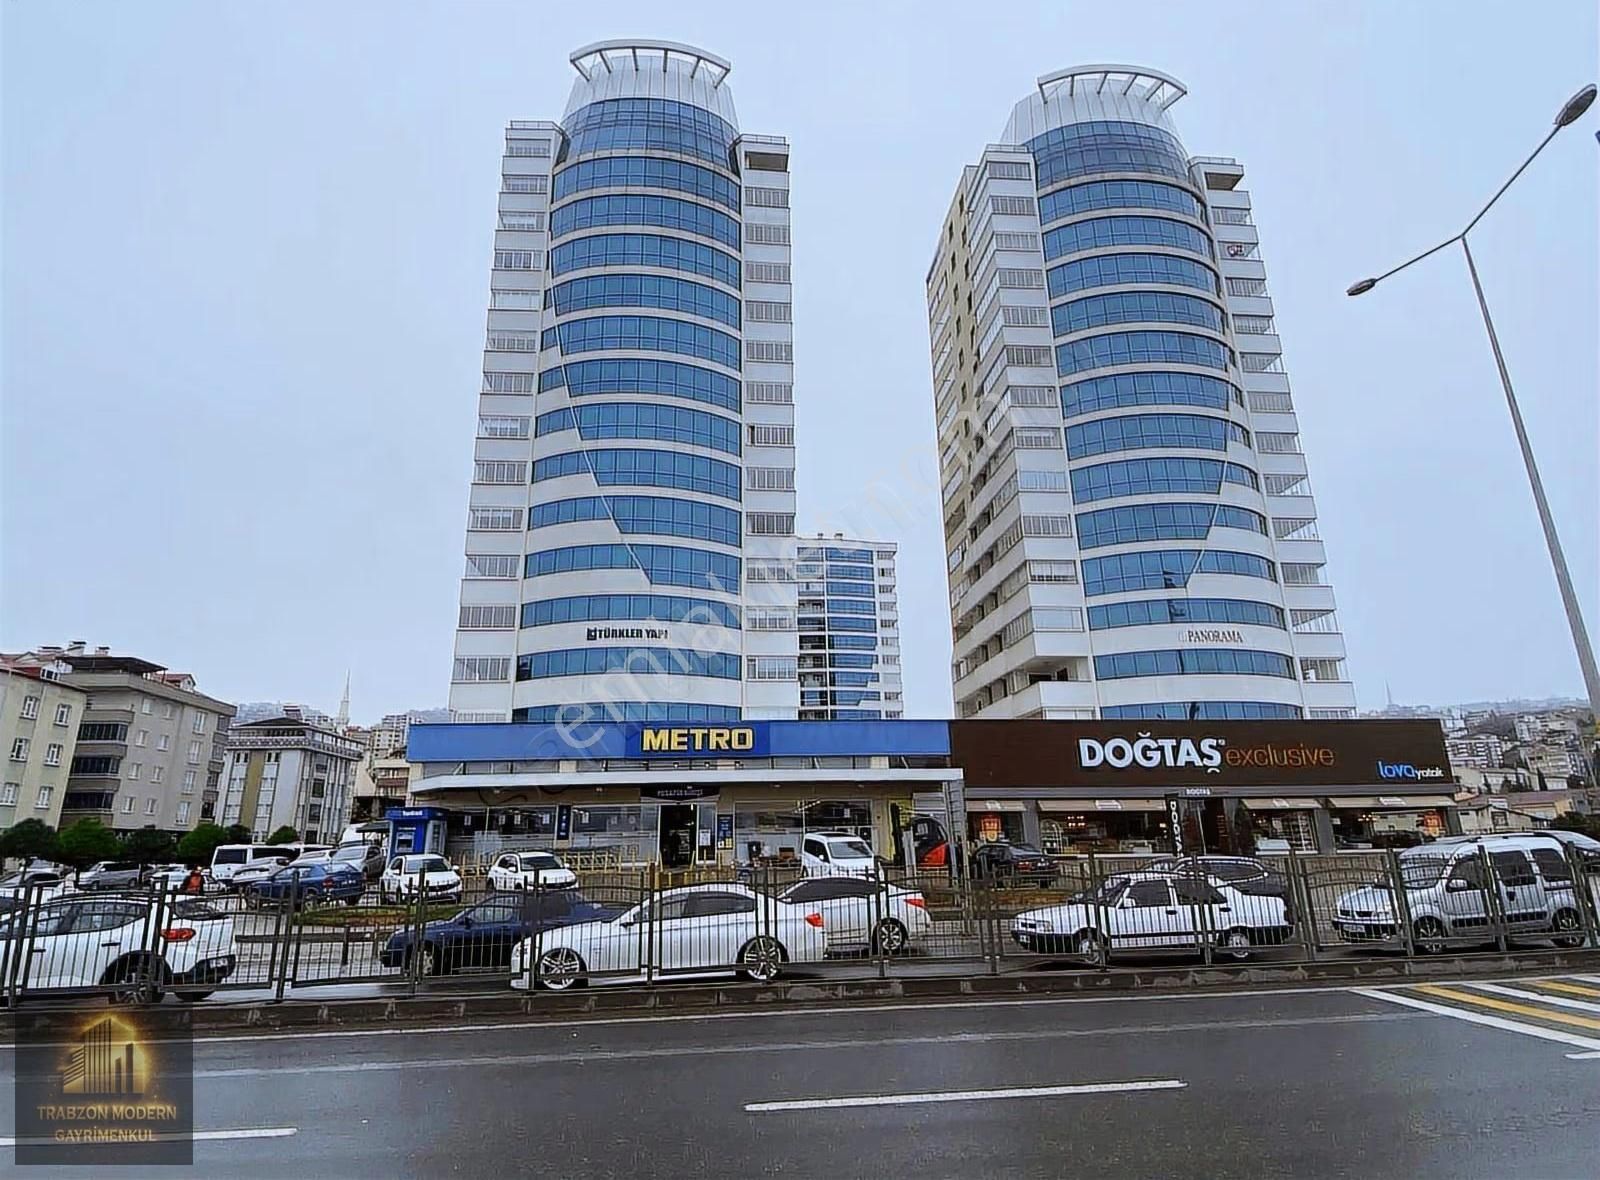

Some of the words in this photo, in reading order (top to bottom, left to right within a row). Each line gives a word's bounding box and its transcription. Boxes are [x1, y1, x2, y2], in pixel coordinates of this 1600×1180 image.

[1187, 629, 1243, 643] PANORAMA
[642, 728, 753, 751] METRO
[1079, 732, 1223, 773] DOĞTAŞ
[1226, 744, 1335, 766] exclusive
